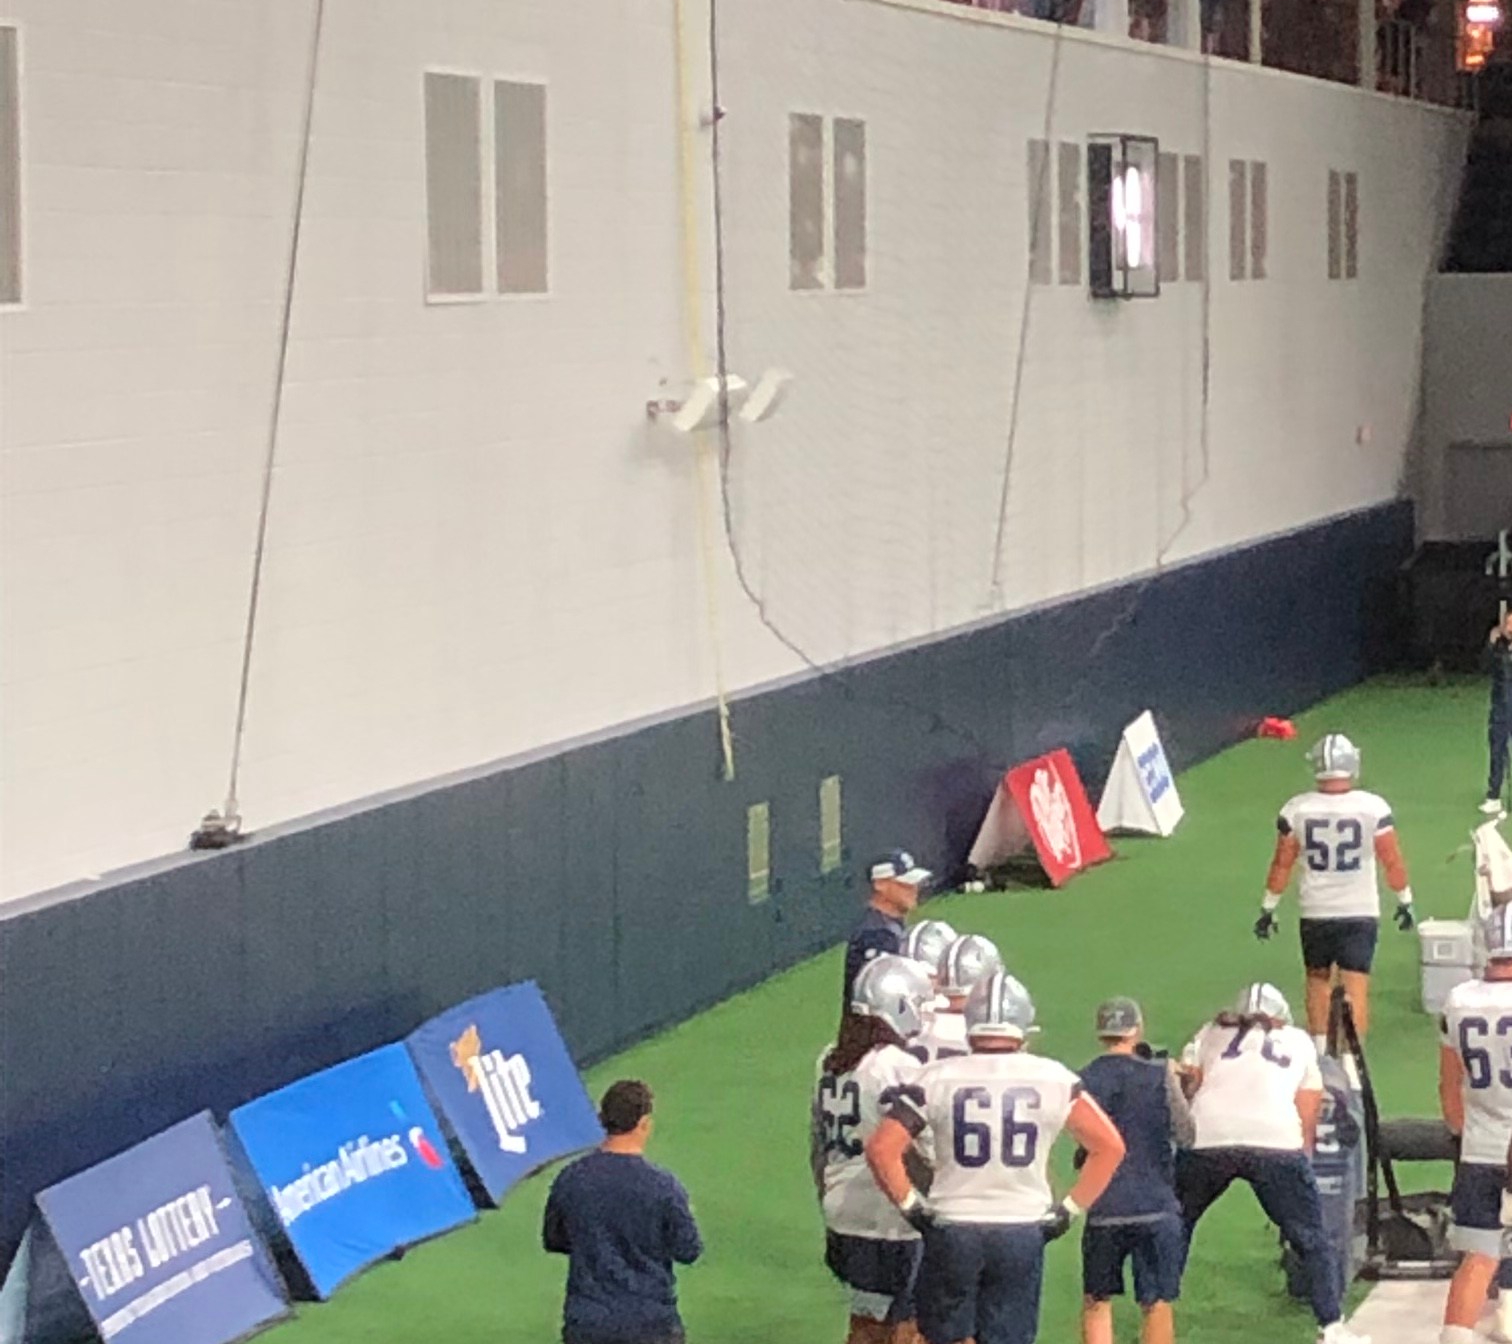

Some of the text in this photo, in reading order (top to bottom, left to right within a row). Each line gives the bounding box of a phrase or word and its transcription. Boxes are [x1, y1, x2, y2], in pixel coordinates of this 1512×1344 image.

[1305, 818, 1362, 873] 52
[952, 1085, 1042, 1169] 66
[137, 1184, 220, 1268] LOTTERY
